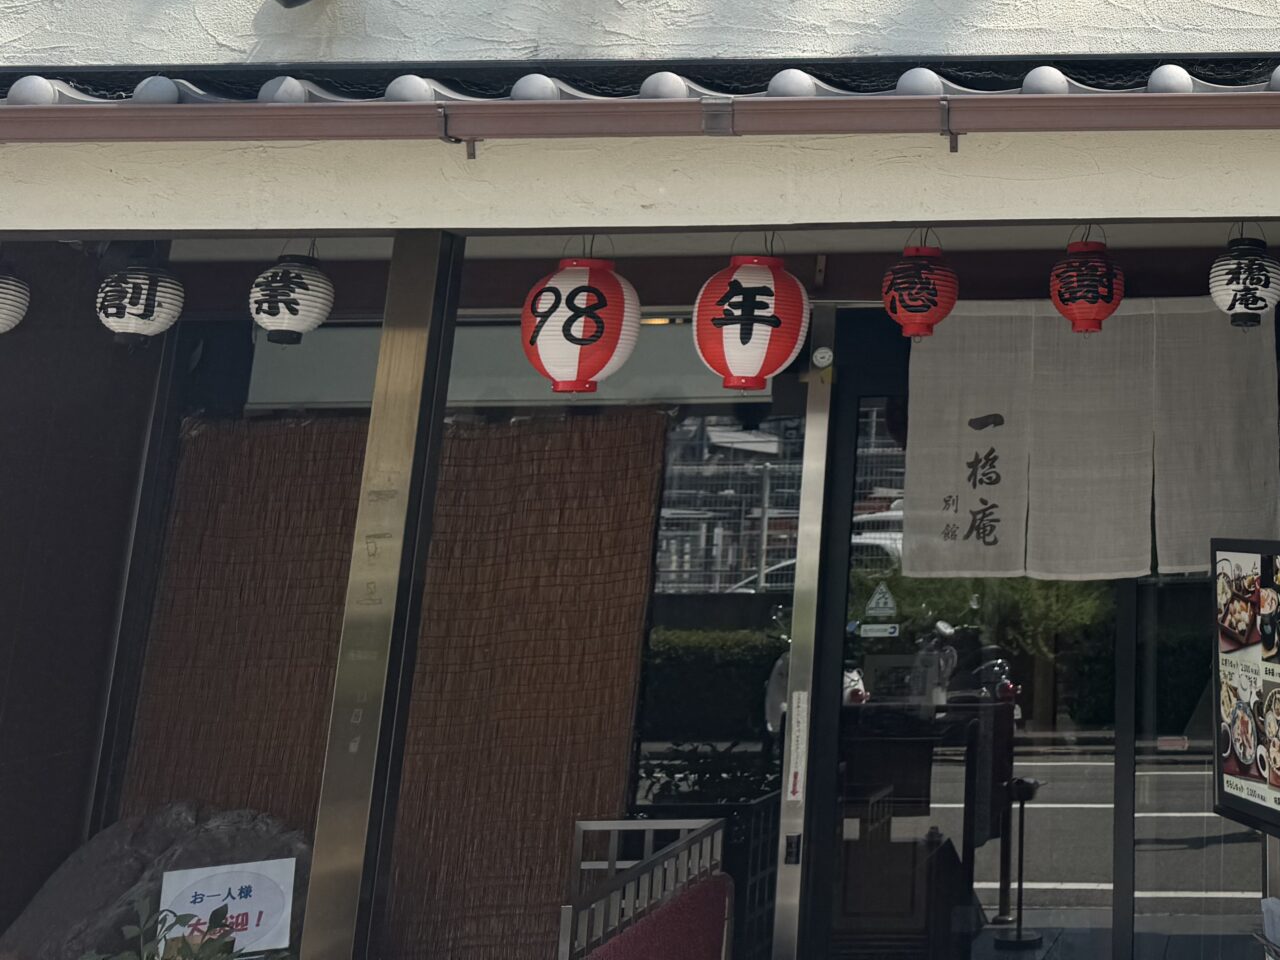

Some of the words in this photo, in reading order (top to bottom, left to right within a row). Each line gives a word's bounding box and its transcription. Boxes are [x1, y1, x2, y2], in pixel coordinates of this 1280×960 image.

[99, 274, 158, 321] 創
[254, 269, 311, 317] 業
[528, 285, 609, 347] 98
[710, 278, 782, 346] 年
[963, 413, 1005, 546] 一橋庵
[190, 884, 253, 905] お一人様
